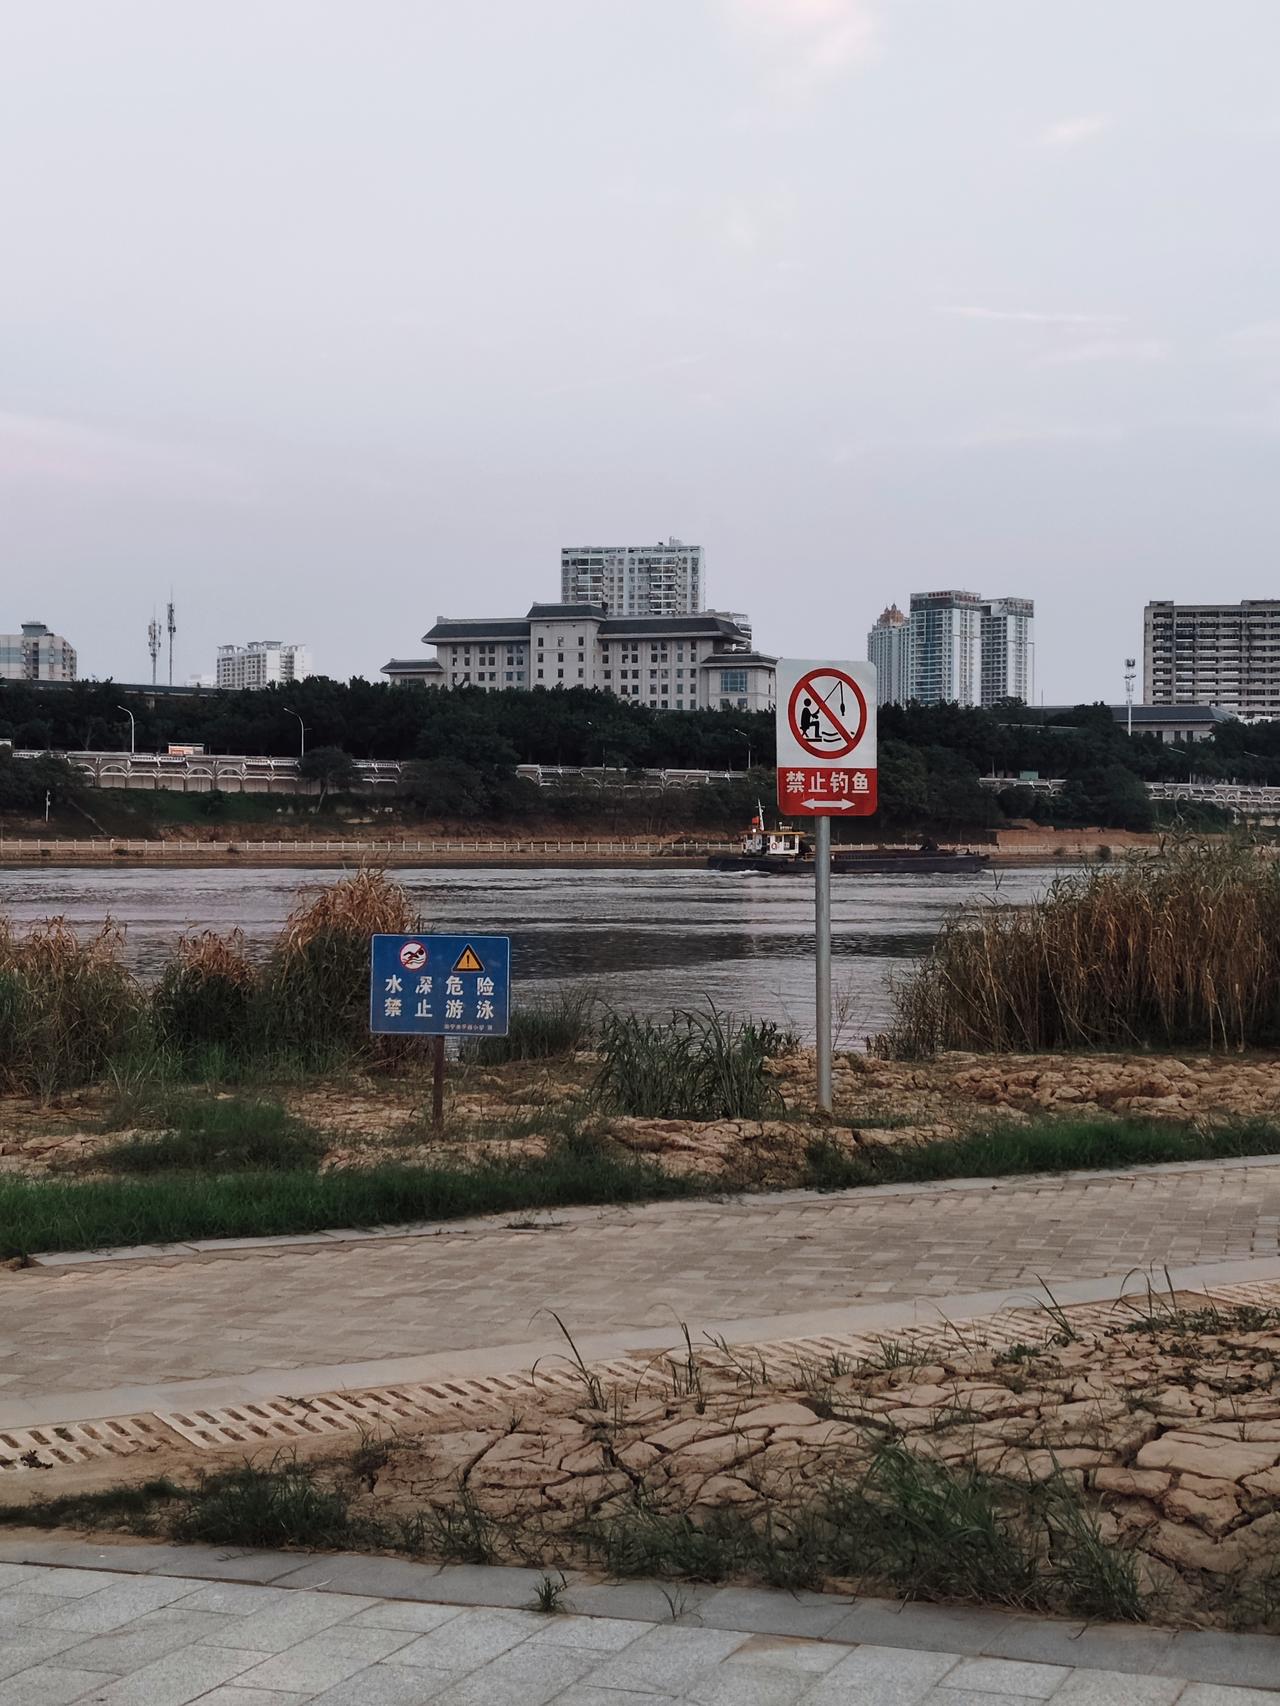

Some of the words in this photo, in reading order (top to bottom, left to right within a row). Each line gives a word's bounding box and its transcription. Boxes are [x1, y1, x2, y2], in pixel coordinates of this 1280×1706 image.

[785, 771, 870, 794] 禁止钓鱼
[384, 974, 495, 996] 水深危险
[384, 997, 495, 1020] 禁止游泳
